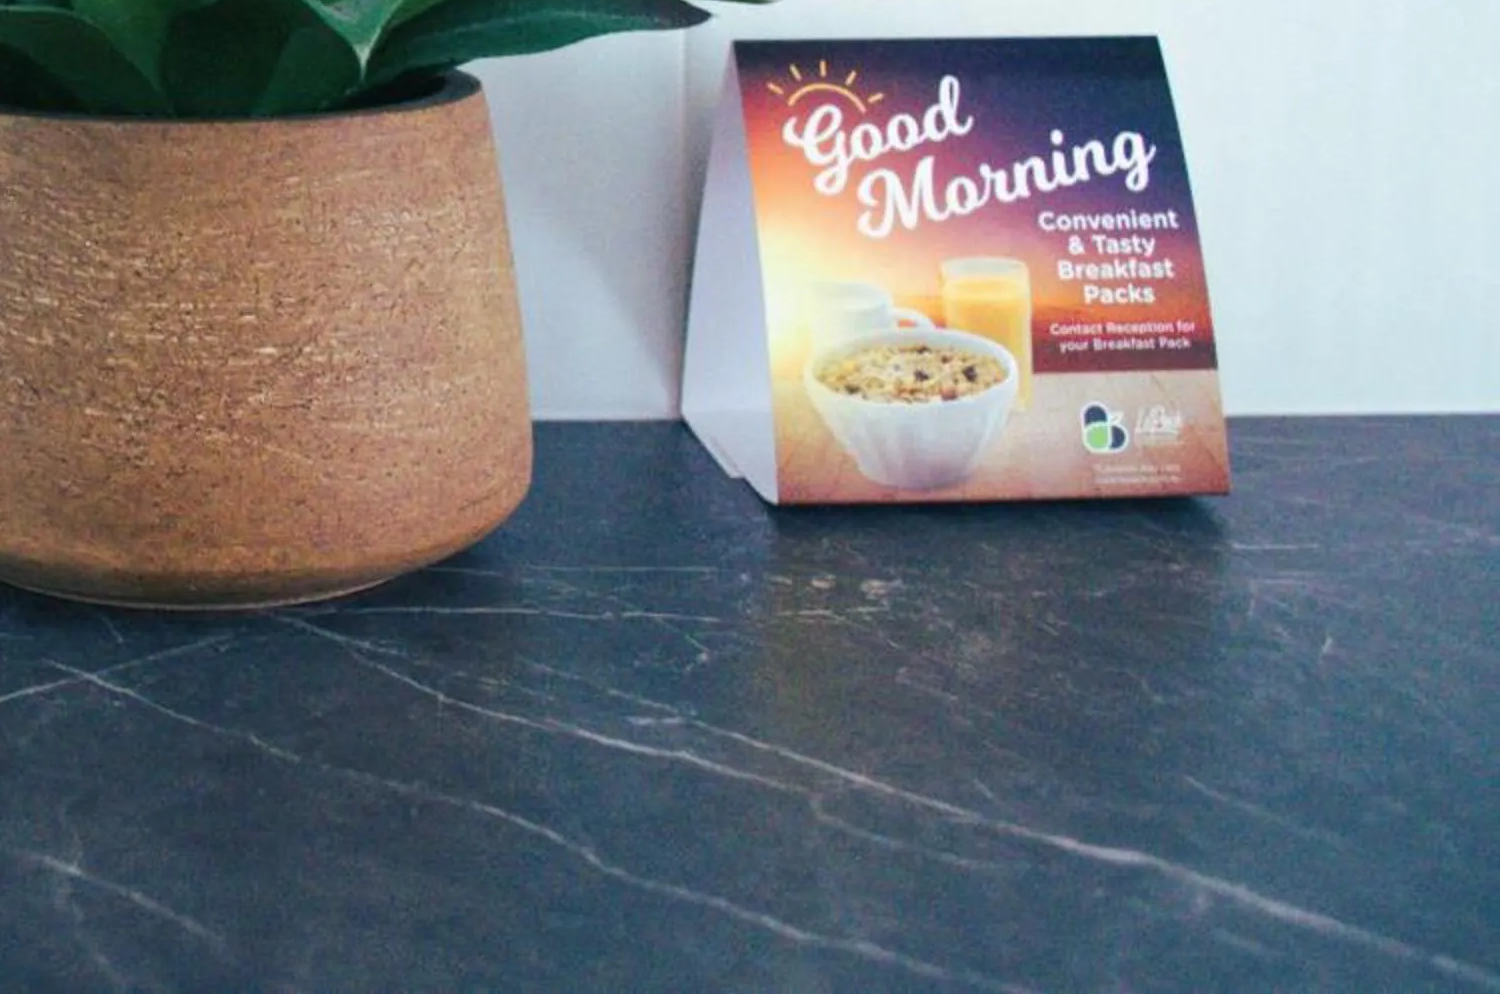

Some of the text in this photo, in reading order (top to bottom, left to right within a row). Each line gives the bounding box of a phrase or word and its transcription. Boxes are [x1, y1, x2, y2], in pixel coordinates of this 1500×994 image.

[782, 74, 975, 196] Good
[857, 128, 1158, 239] Morning
[1037, 209, 1180, 231] Convenient
[1068, 233, 1156, 257] & Tasty
[1057, 257, 1175, 280] Breakfast
[1083, 283, 1156, 304] Packs
[1050, 320, 1195, 335] Contact Reception for
[1060, 336, 1191, 354] your Breakfast Pack
